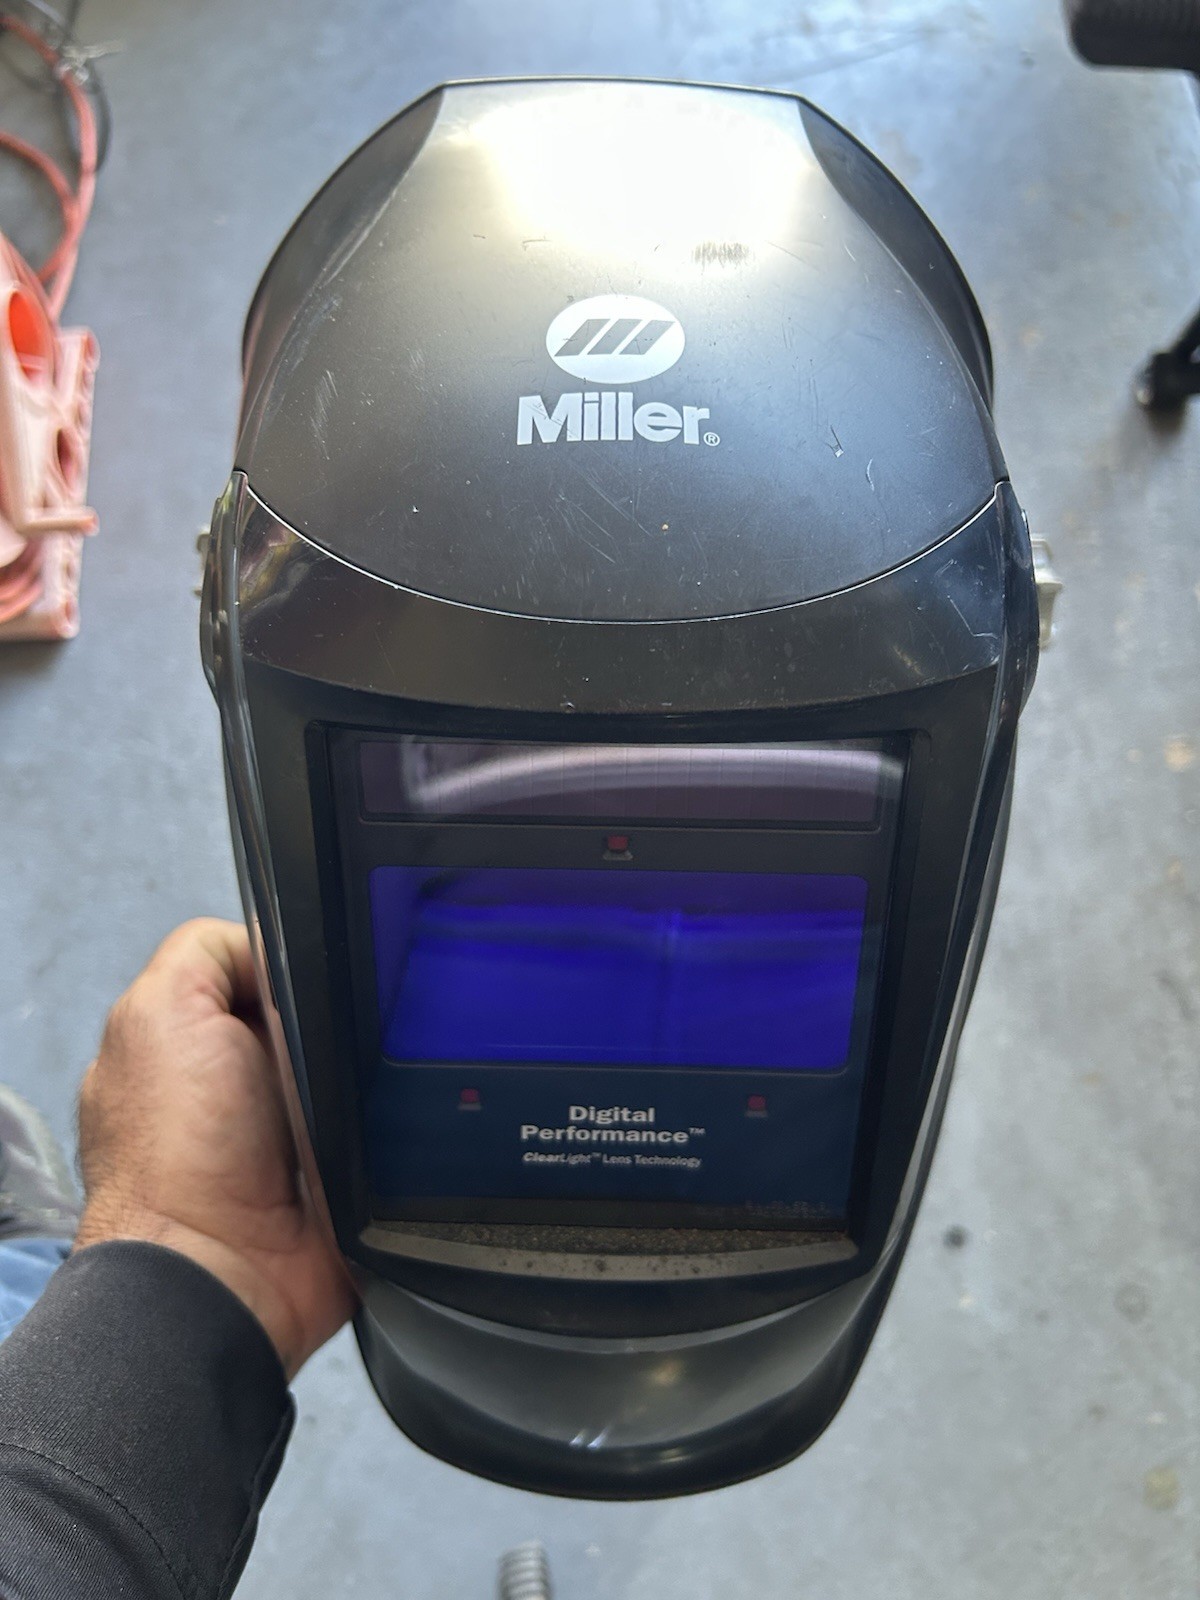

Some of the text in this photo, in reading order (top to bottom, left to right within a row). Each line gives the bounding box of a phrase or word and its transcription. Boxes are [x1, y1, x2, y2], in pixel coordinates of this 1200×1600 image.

[568, 1105, 656, 1124] Digital
[602, 1153, 632, 1164] Lens
[634, 1154, 701, 1168] Technology
